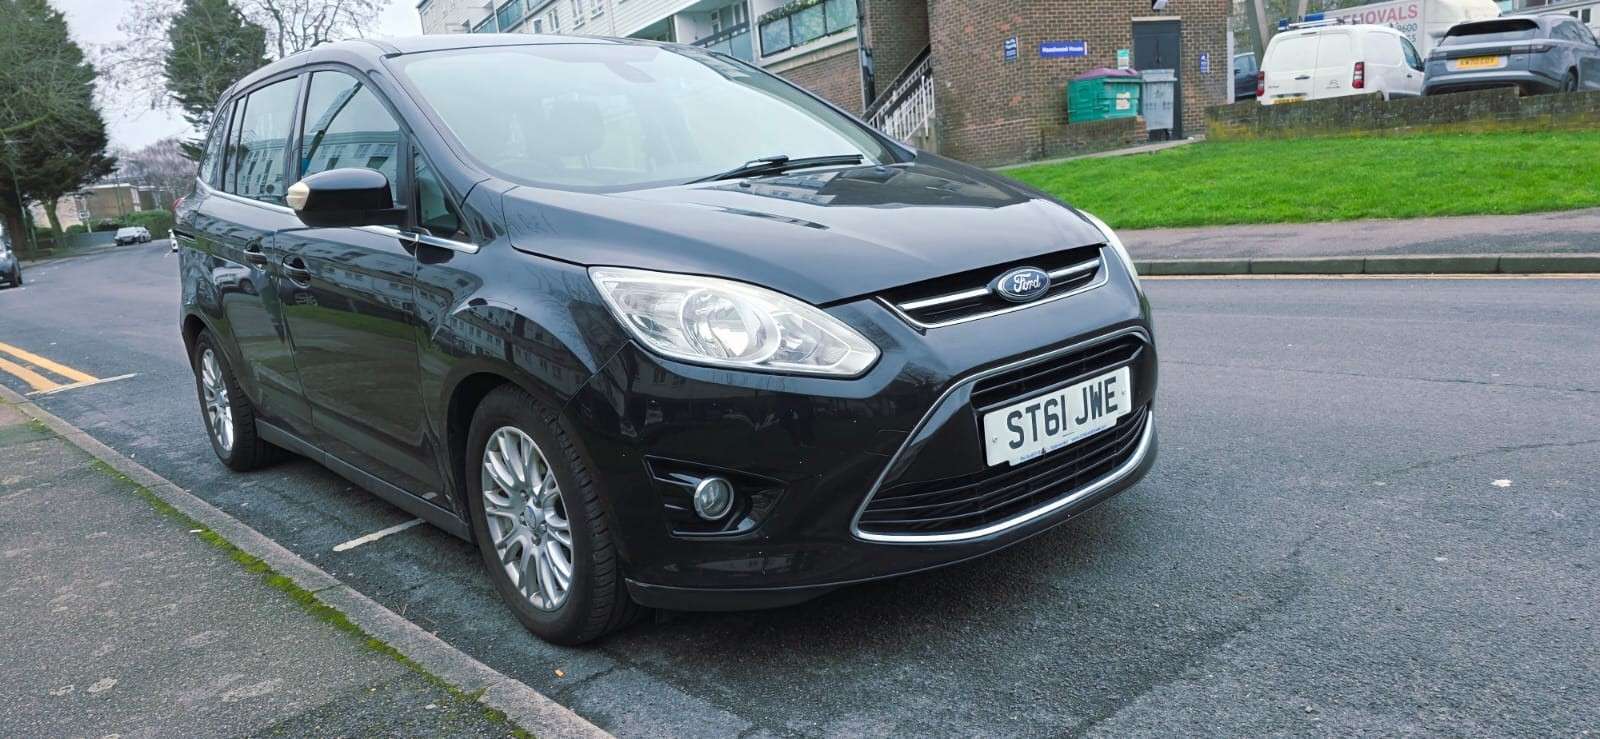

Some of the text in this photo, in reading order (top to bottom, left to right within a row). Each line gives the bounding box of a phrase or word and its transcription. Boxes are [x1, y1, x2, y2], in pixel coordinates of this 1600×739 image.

[1013, 273, 1041, 293] Ford
[1007, 395, 1067, 450] ST61
[1075, 376, 1118, 426] JWE
